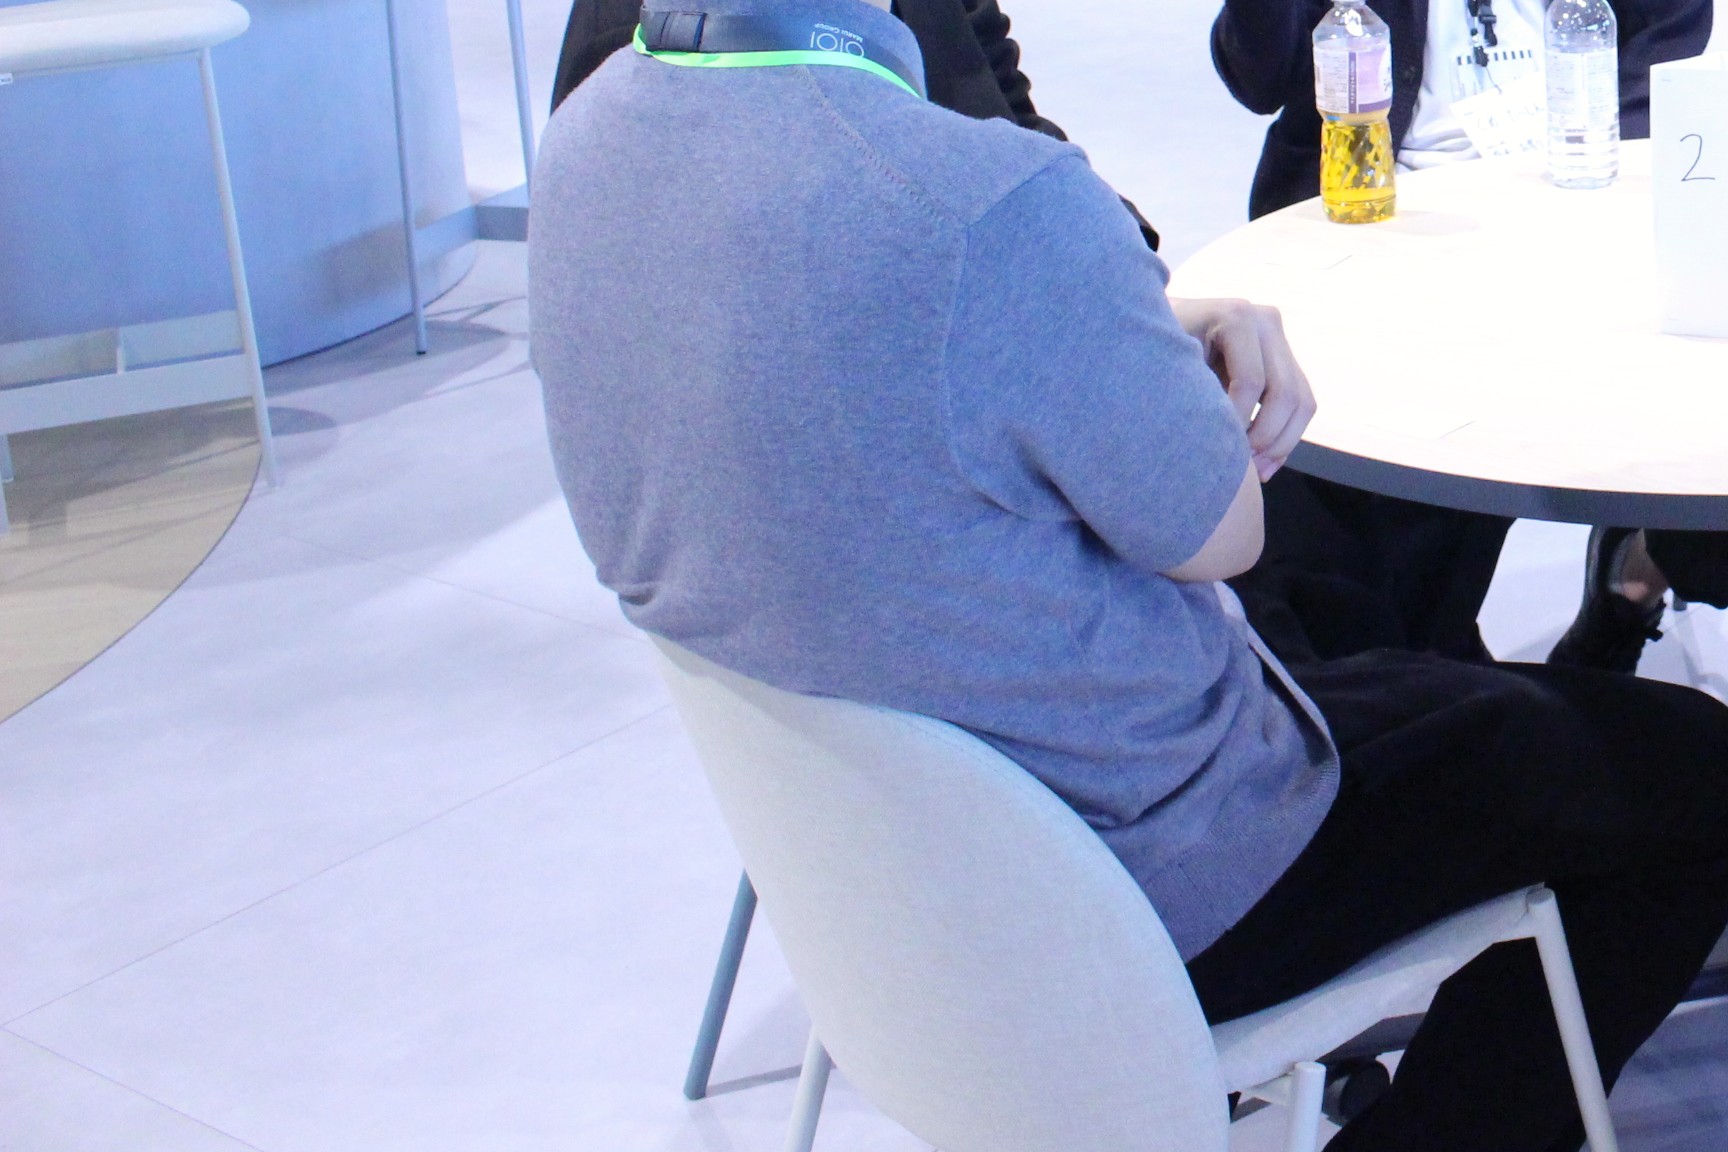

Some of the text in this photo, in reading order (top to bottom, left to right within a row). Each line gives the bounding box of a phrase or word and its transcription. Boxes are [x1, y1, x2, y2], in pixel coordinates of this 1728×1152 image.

[814, 23, 863, 43] MARUI GROUP
[1680, 133, 1715, 181] 2
